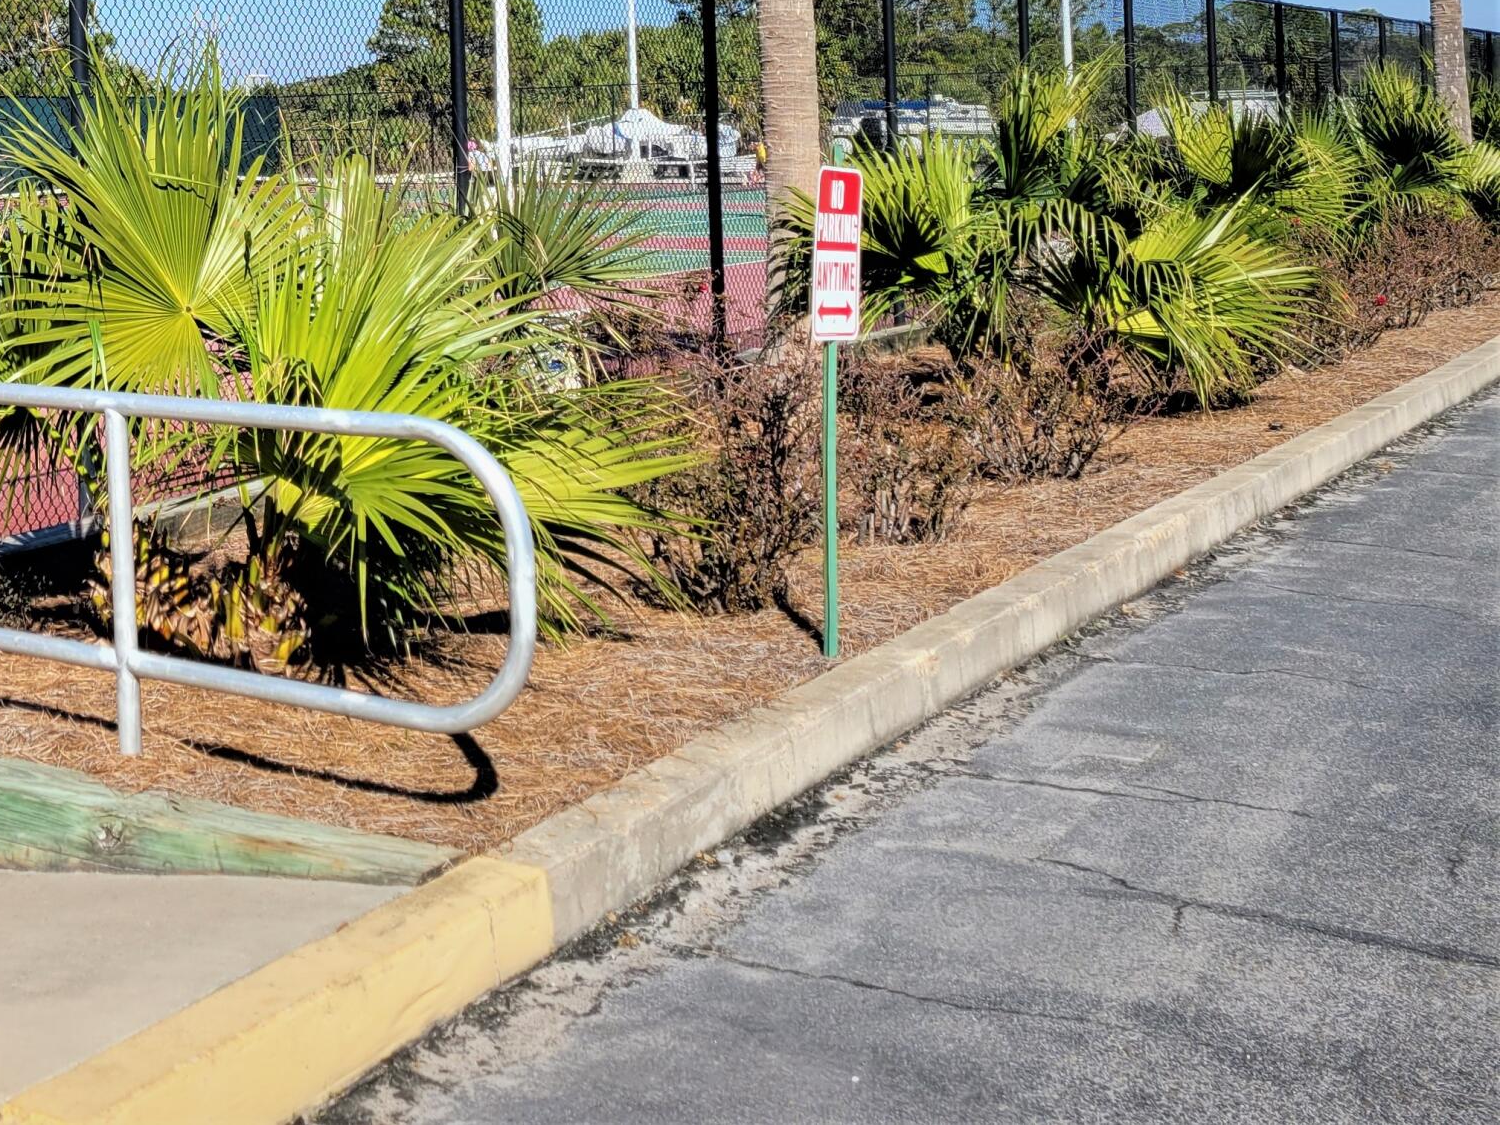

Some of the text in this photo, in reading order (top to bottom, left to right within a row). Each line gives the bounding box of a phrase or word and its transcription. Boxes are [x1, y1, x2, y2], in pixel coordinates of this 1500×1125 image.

[830, 180, 845, 210] NO
[817, 212, 858, 243] PARKING
[816, 261, 856, 292] ANYTIME
